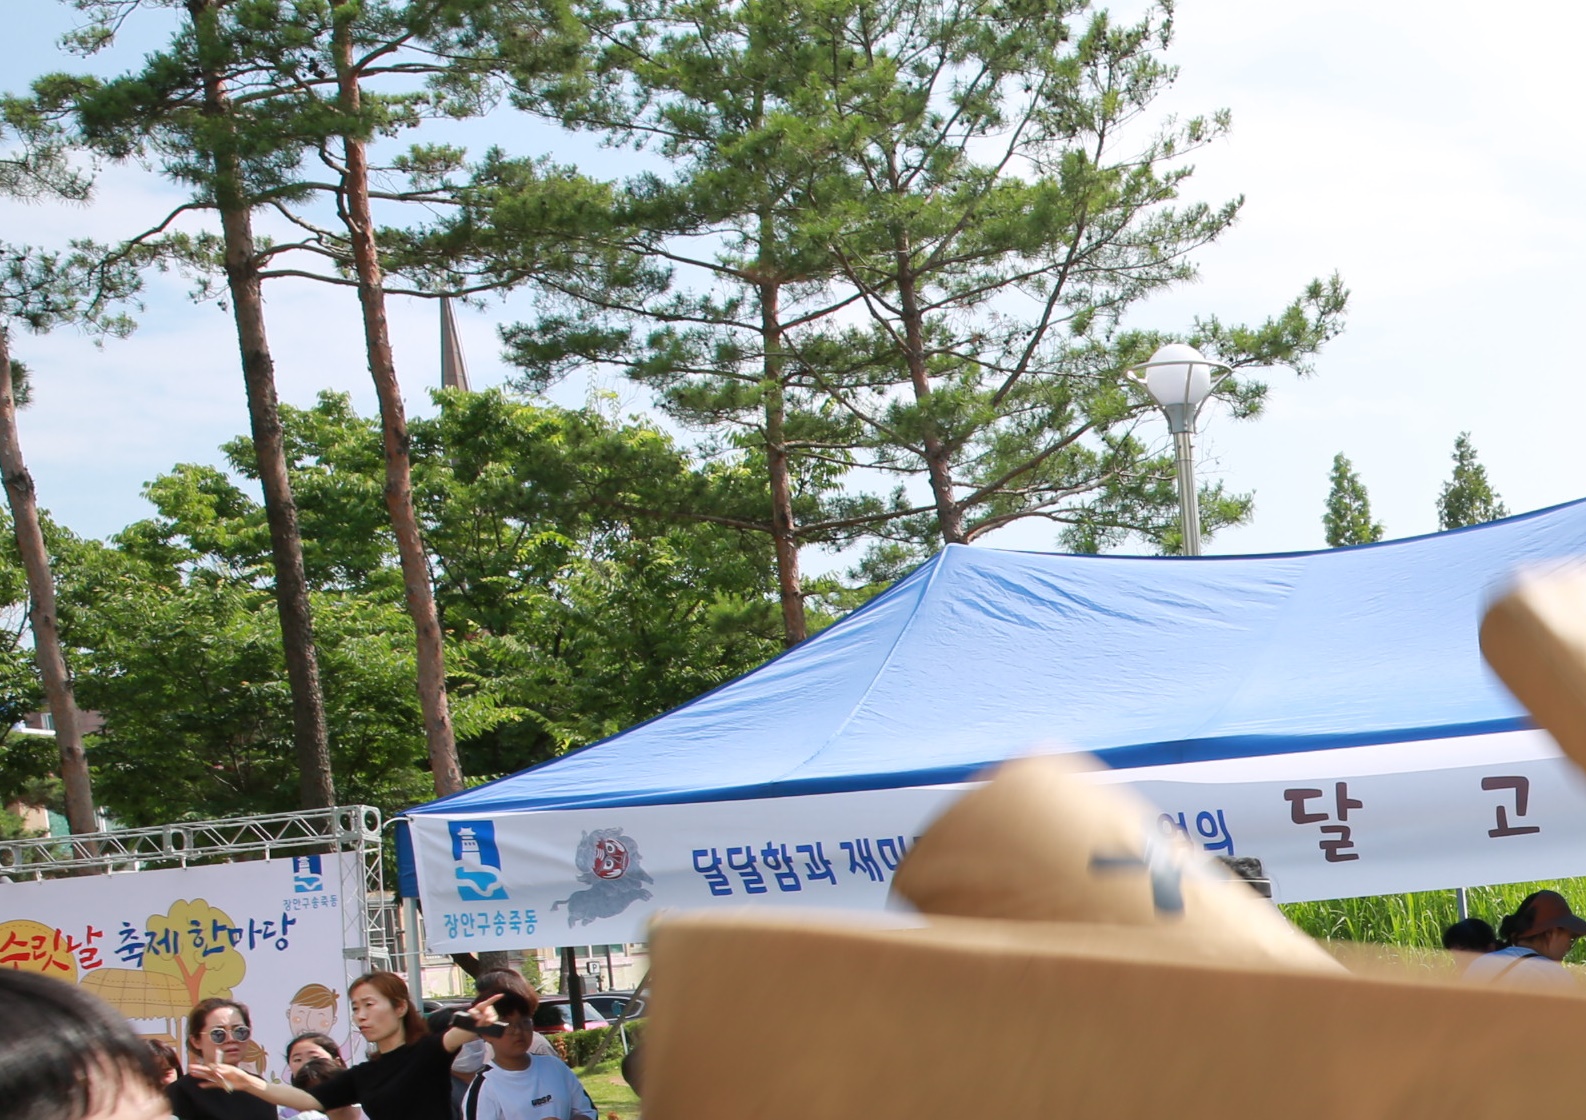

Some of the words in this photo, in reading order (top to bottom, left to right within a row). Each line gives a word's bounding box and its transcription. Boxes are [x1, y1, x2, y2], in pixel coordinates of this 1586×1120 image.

[691, 840, 838, 897] 달달함과
[839, 832, 918, 883] 재미
[283, 894, 339, 912] 장안구송죽동
[443, 909, 539, 940] 장안구송죽동
[0, 925, 104, 972] 수릿날
[114, 920, 180, 968] 축제
[187, 911, 297, 957] 한마당
